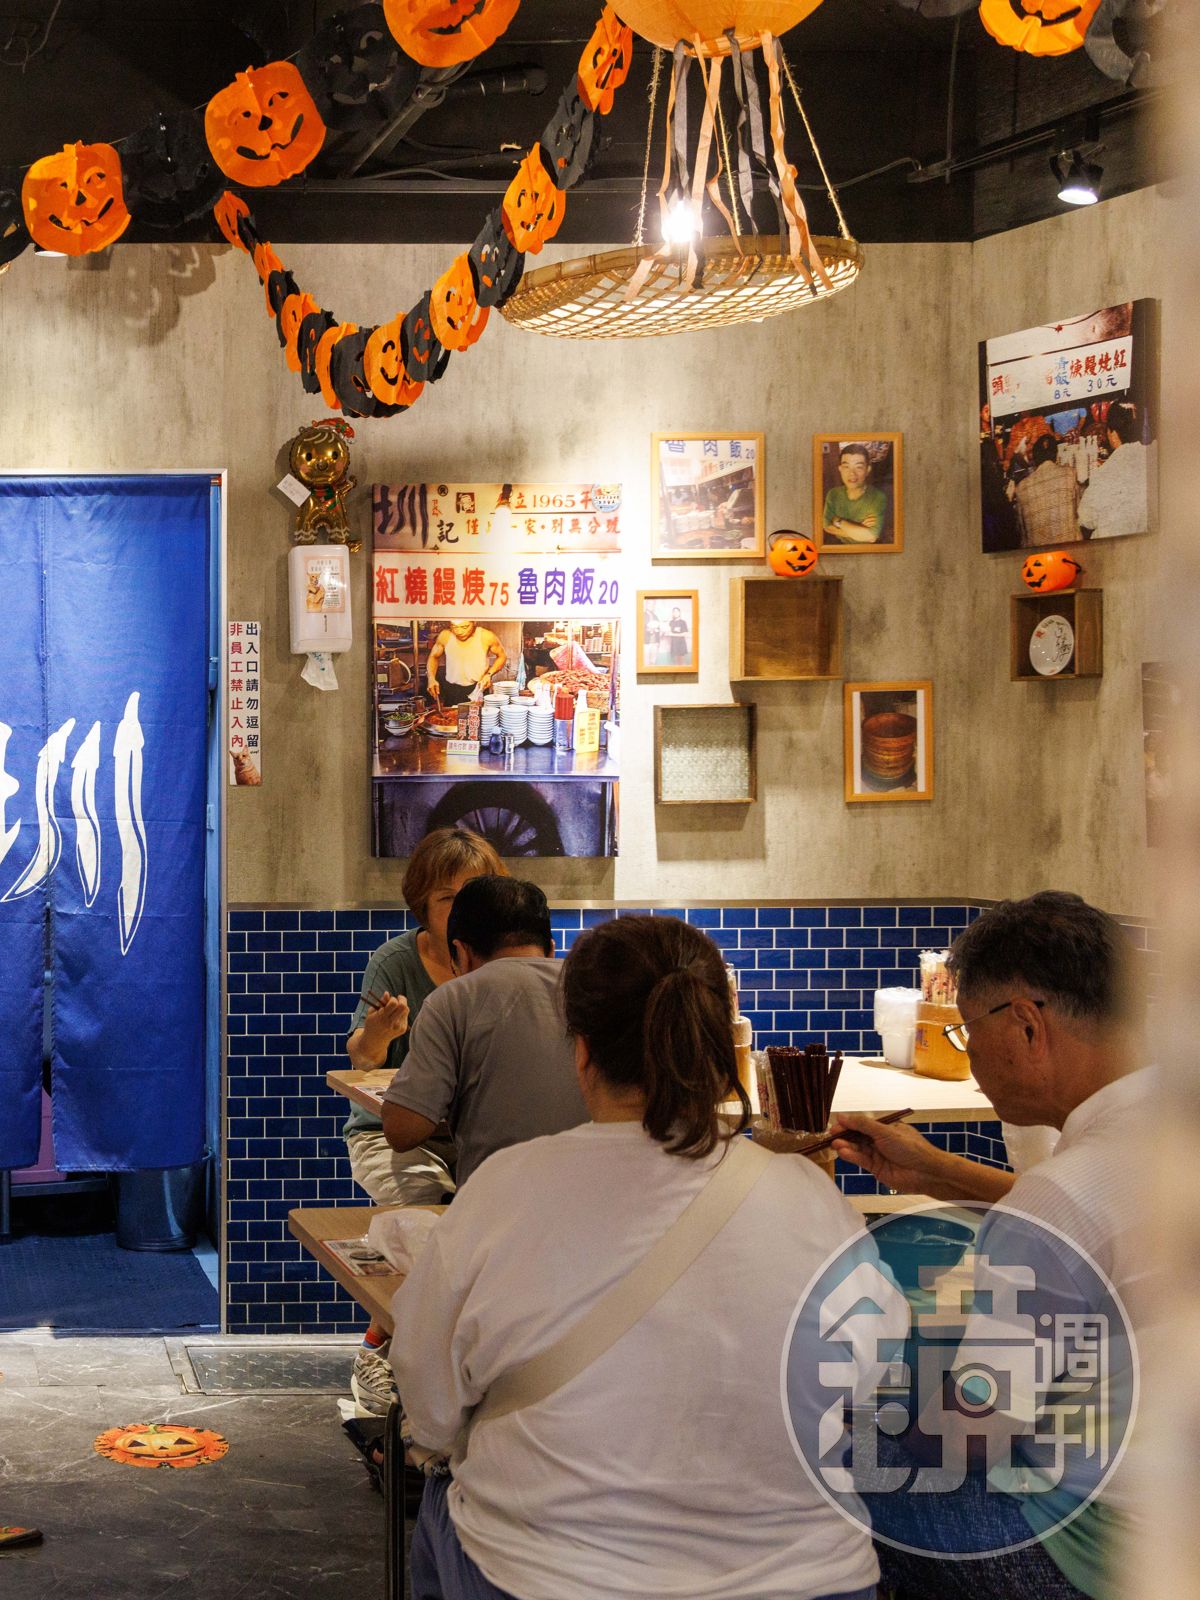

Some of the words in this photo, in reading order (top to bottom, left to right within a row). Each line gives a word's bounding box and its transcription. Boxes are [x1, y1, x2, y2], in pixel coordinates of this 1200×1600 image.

[230, 622, 244, 748] 非員工禁止入內
[246, 622, 259, 748] 出入口請勿逗留
